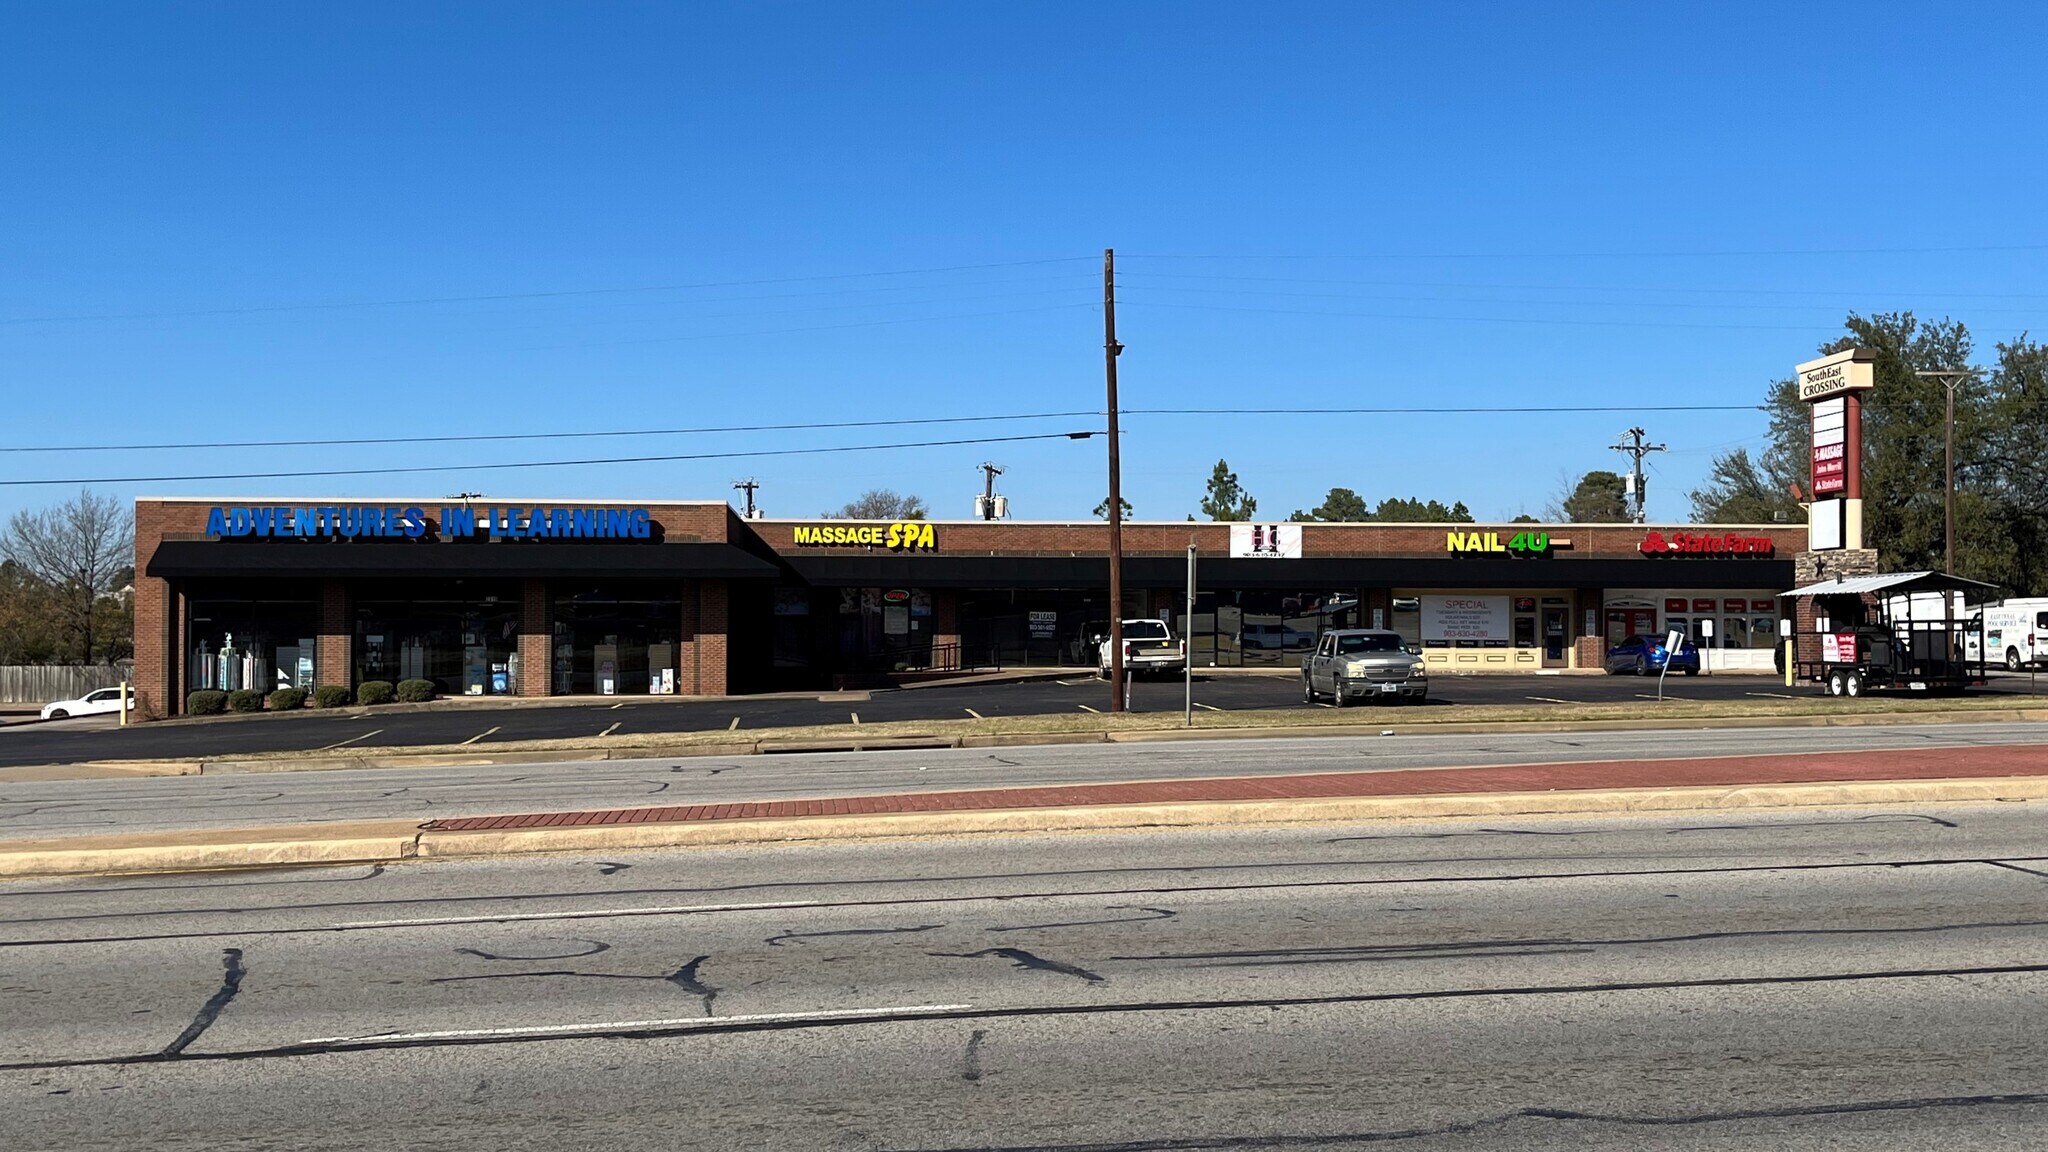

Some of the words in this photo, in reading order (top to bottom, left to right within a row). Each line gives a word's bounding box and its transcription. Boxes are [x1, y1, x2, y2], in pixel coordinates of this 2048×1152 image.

[1804, 376, 1845, 397] CROSSING
[1819, 444, 1843, 461] MASSAGE
[206, 507, 424, 538] ADVENTURES
[441, 507, 474, 537] IN
[489, 508, 650, 538] LEARNING
[794, 527, 883, 544] MASSAGE
[886, 523, 934, 548] SPA
[1447, 532, 1506, 552] NAIL
[1508, 532, 1548, 551] 4U
[1445, 600, 1488, 609] SPECIAL
